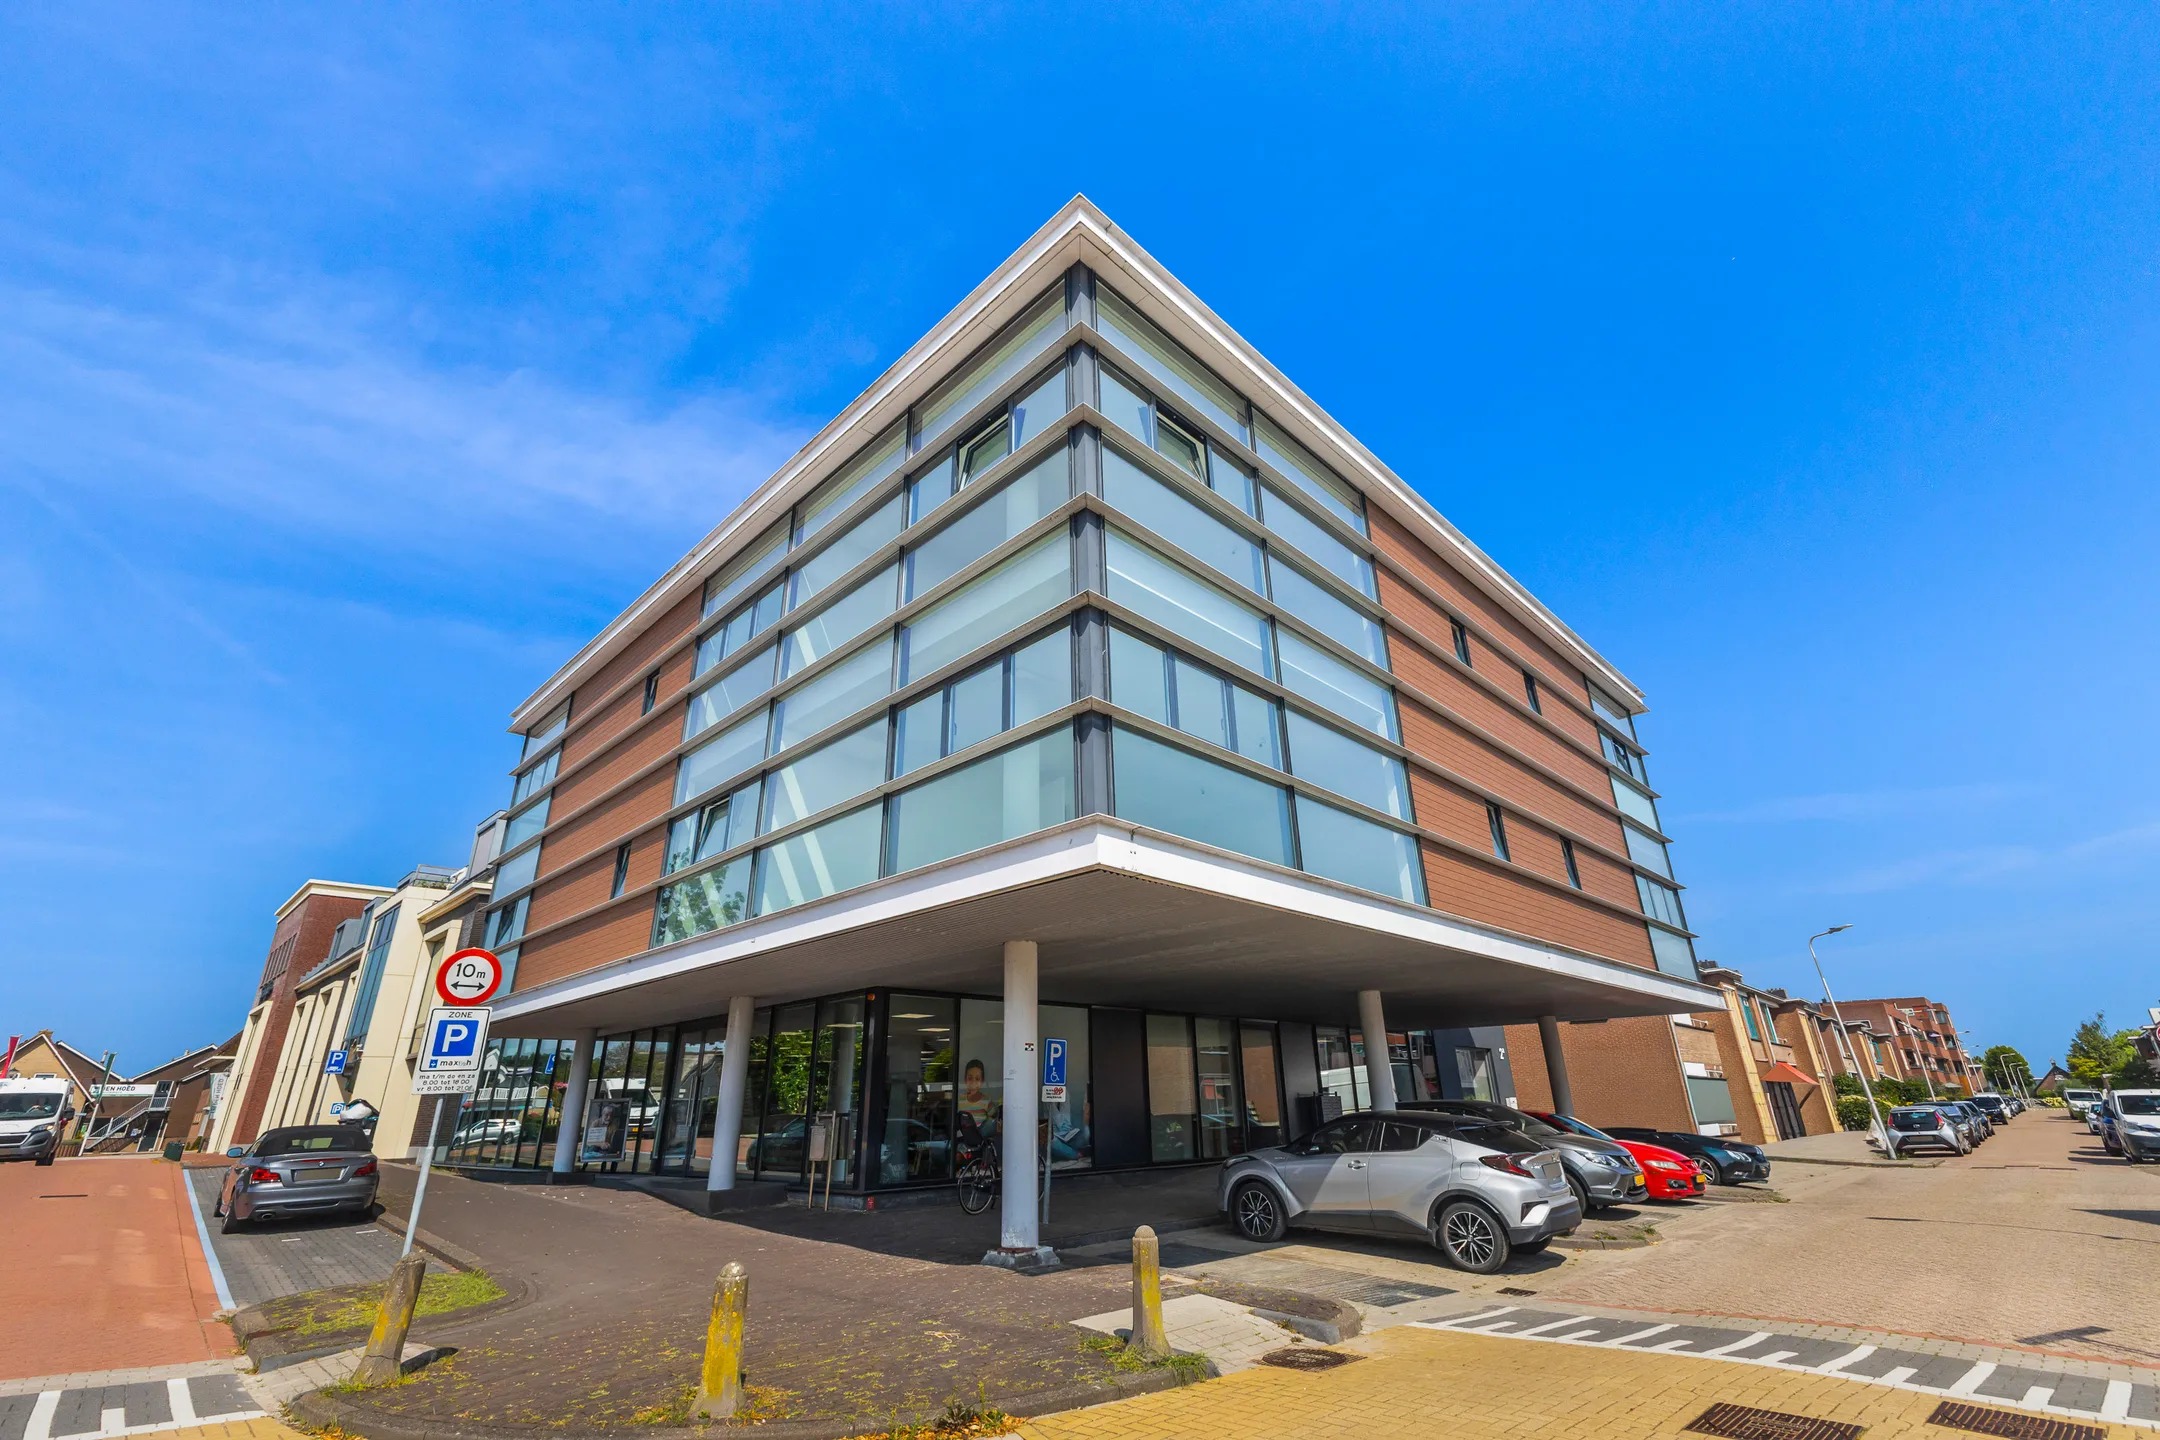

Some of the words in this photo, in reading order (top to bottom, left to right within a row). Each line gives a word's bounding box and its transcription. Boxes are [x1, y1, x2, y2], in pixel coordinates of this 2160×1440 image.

[441, 1024, 468, 1052] P
[331, 1052, 343, 1064] P
[1050, 1043, 1062, 1066] P
